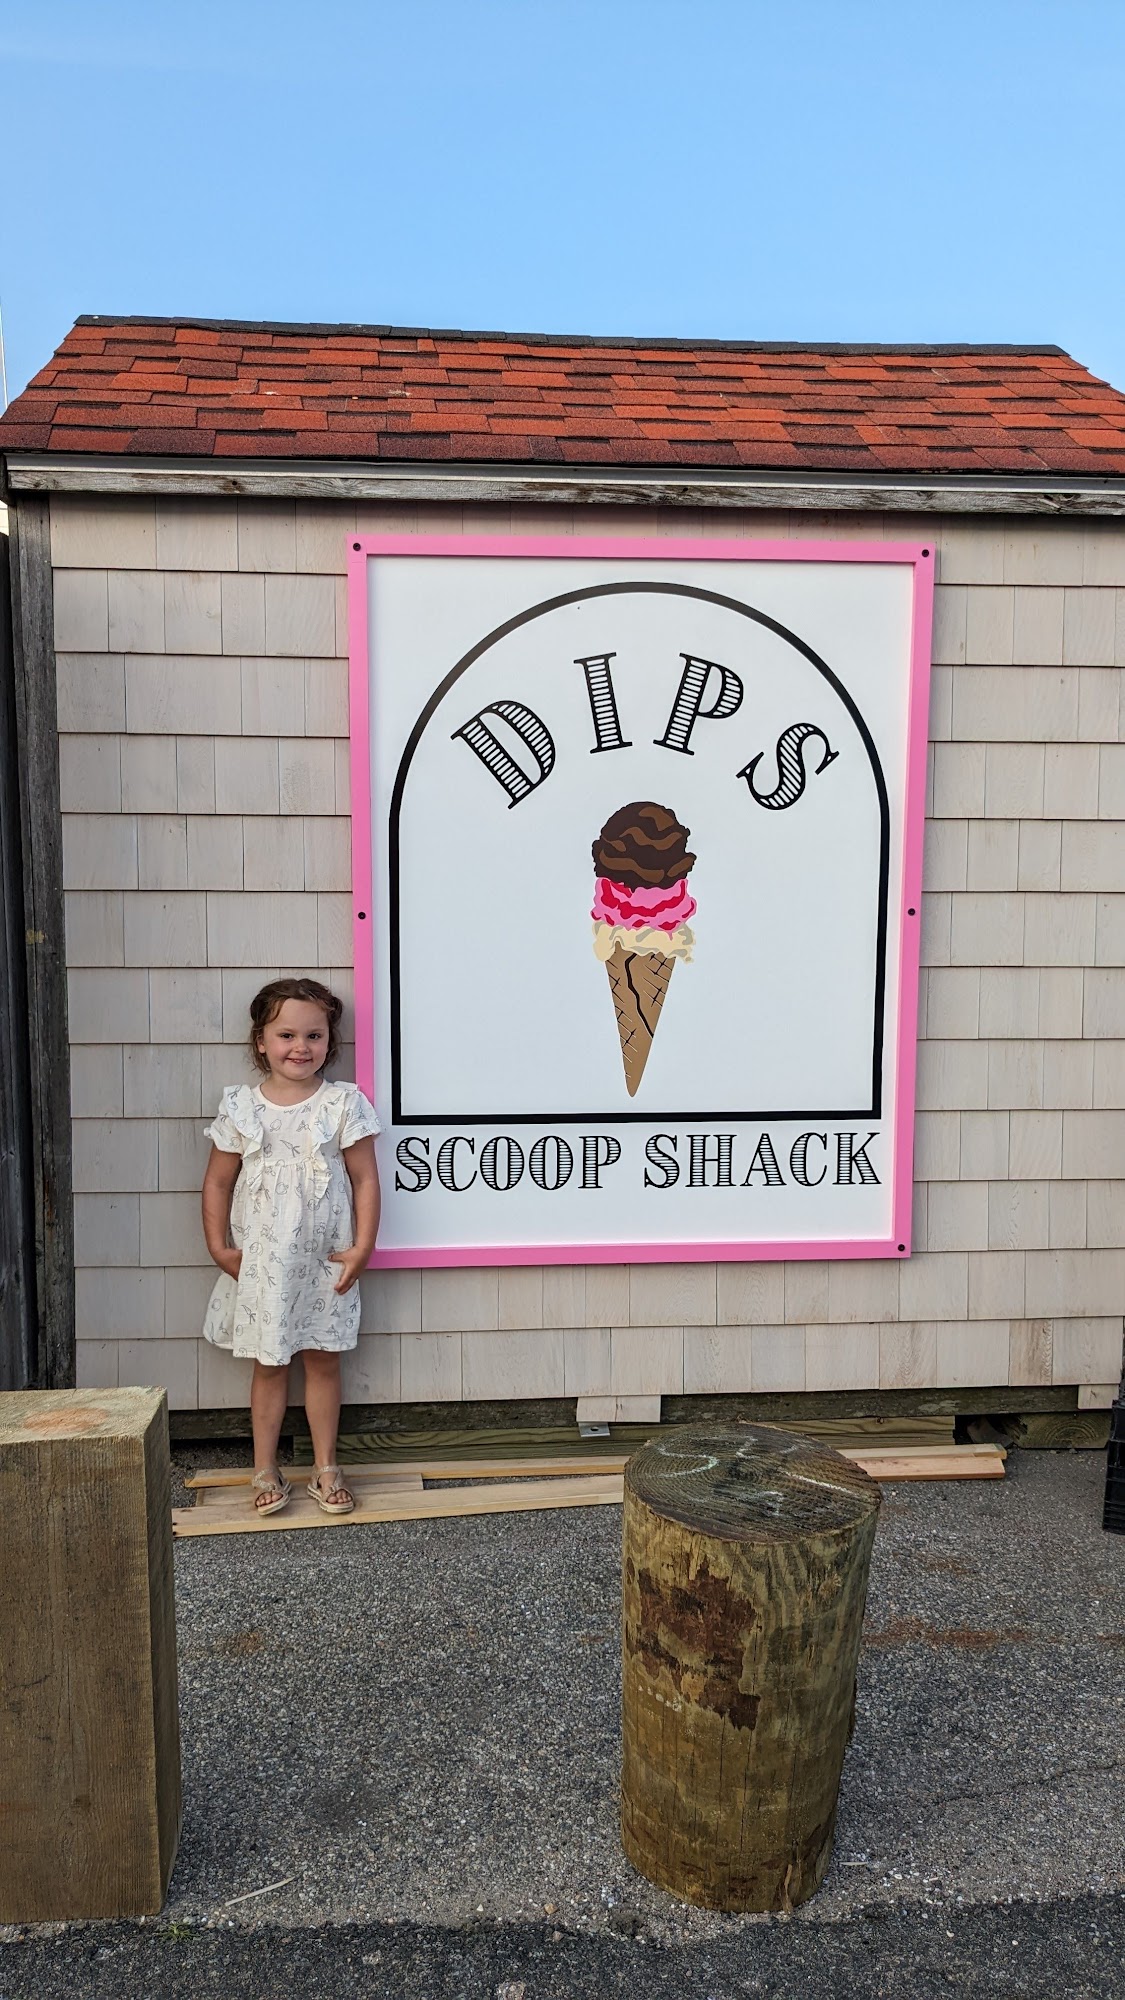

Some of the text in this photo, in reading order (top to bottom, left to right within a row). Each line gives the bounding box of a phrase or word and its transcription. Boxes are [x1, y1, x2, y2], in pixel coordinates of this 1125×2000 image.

[450, 652, 839, 810] DIPS
[395, 1132, 882, 1192] SCOOP SHACK
